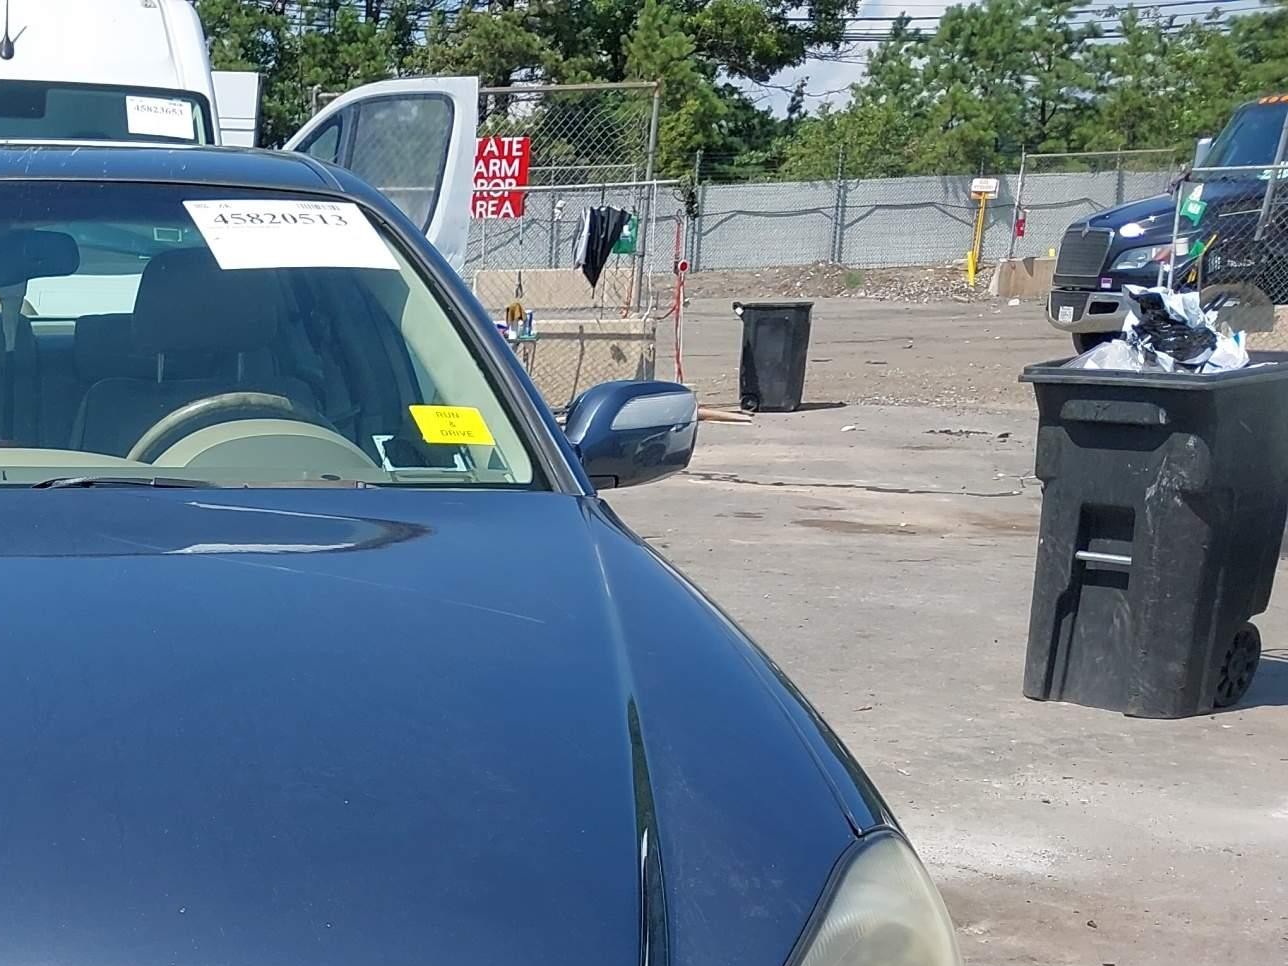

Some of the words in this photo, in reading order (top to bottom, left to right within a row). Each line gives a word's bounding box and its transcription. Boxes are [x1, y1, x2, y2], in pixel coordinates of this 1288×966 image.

[472, 178, 517, 198] ROP
[470, 200, 515, 218] REA
[214, 212, 348, 227] 45820513
[435, 411, 460, 419] RUN
[440, 429, 475, 438] DRIVE
